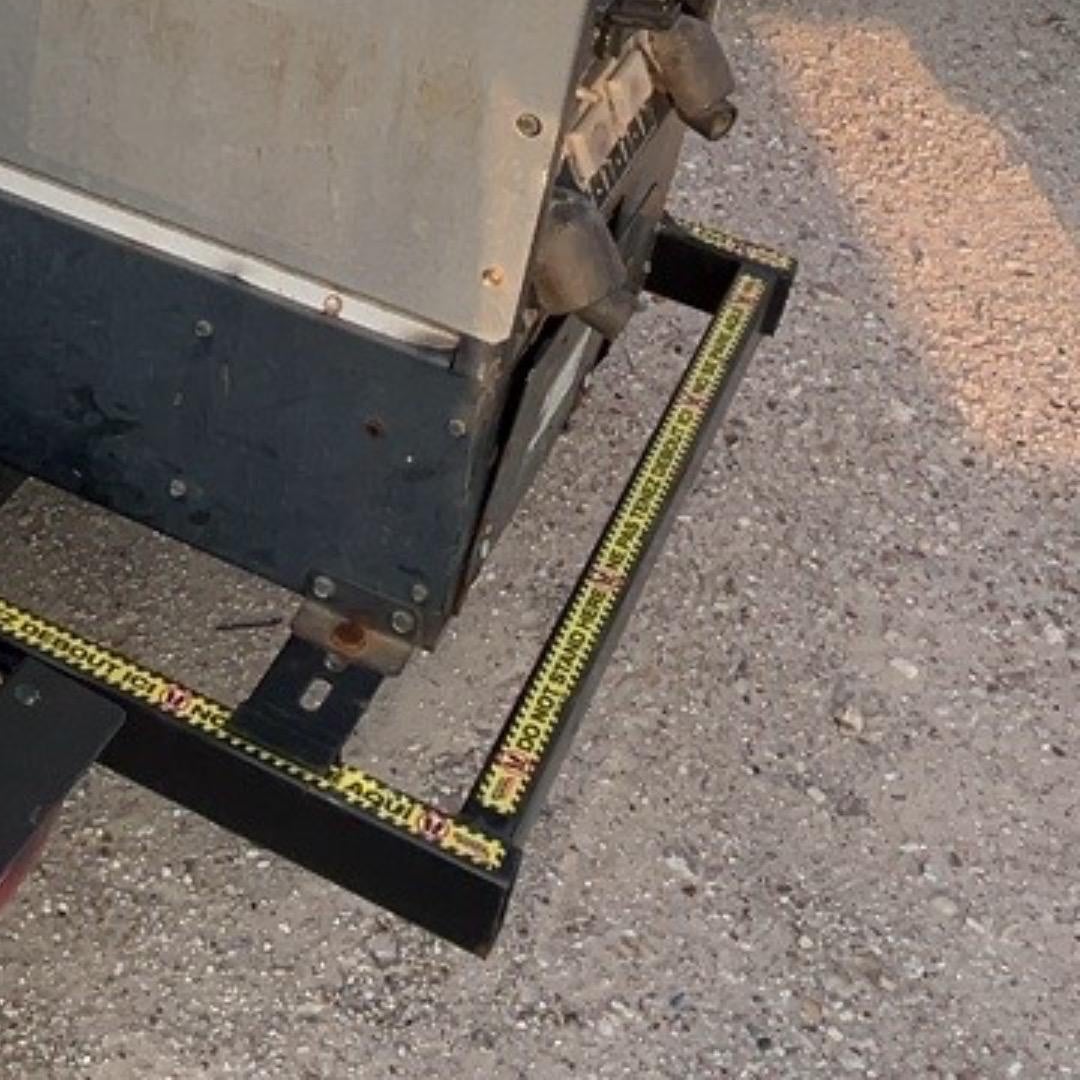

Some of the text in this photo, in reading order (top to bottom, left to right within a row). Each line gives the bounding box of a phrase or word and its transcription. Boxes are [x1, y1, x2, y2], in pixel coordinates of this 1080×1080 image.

[20, 619, 116, 673] DEBOUT
[120, 667, 158, 695] ICI
[514, 587, 609, 753] DO NOT STAND HERE
[347, 779, 412, 820] AQUI
